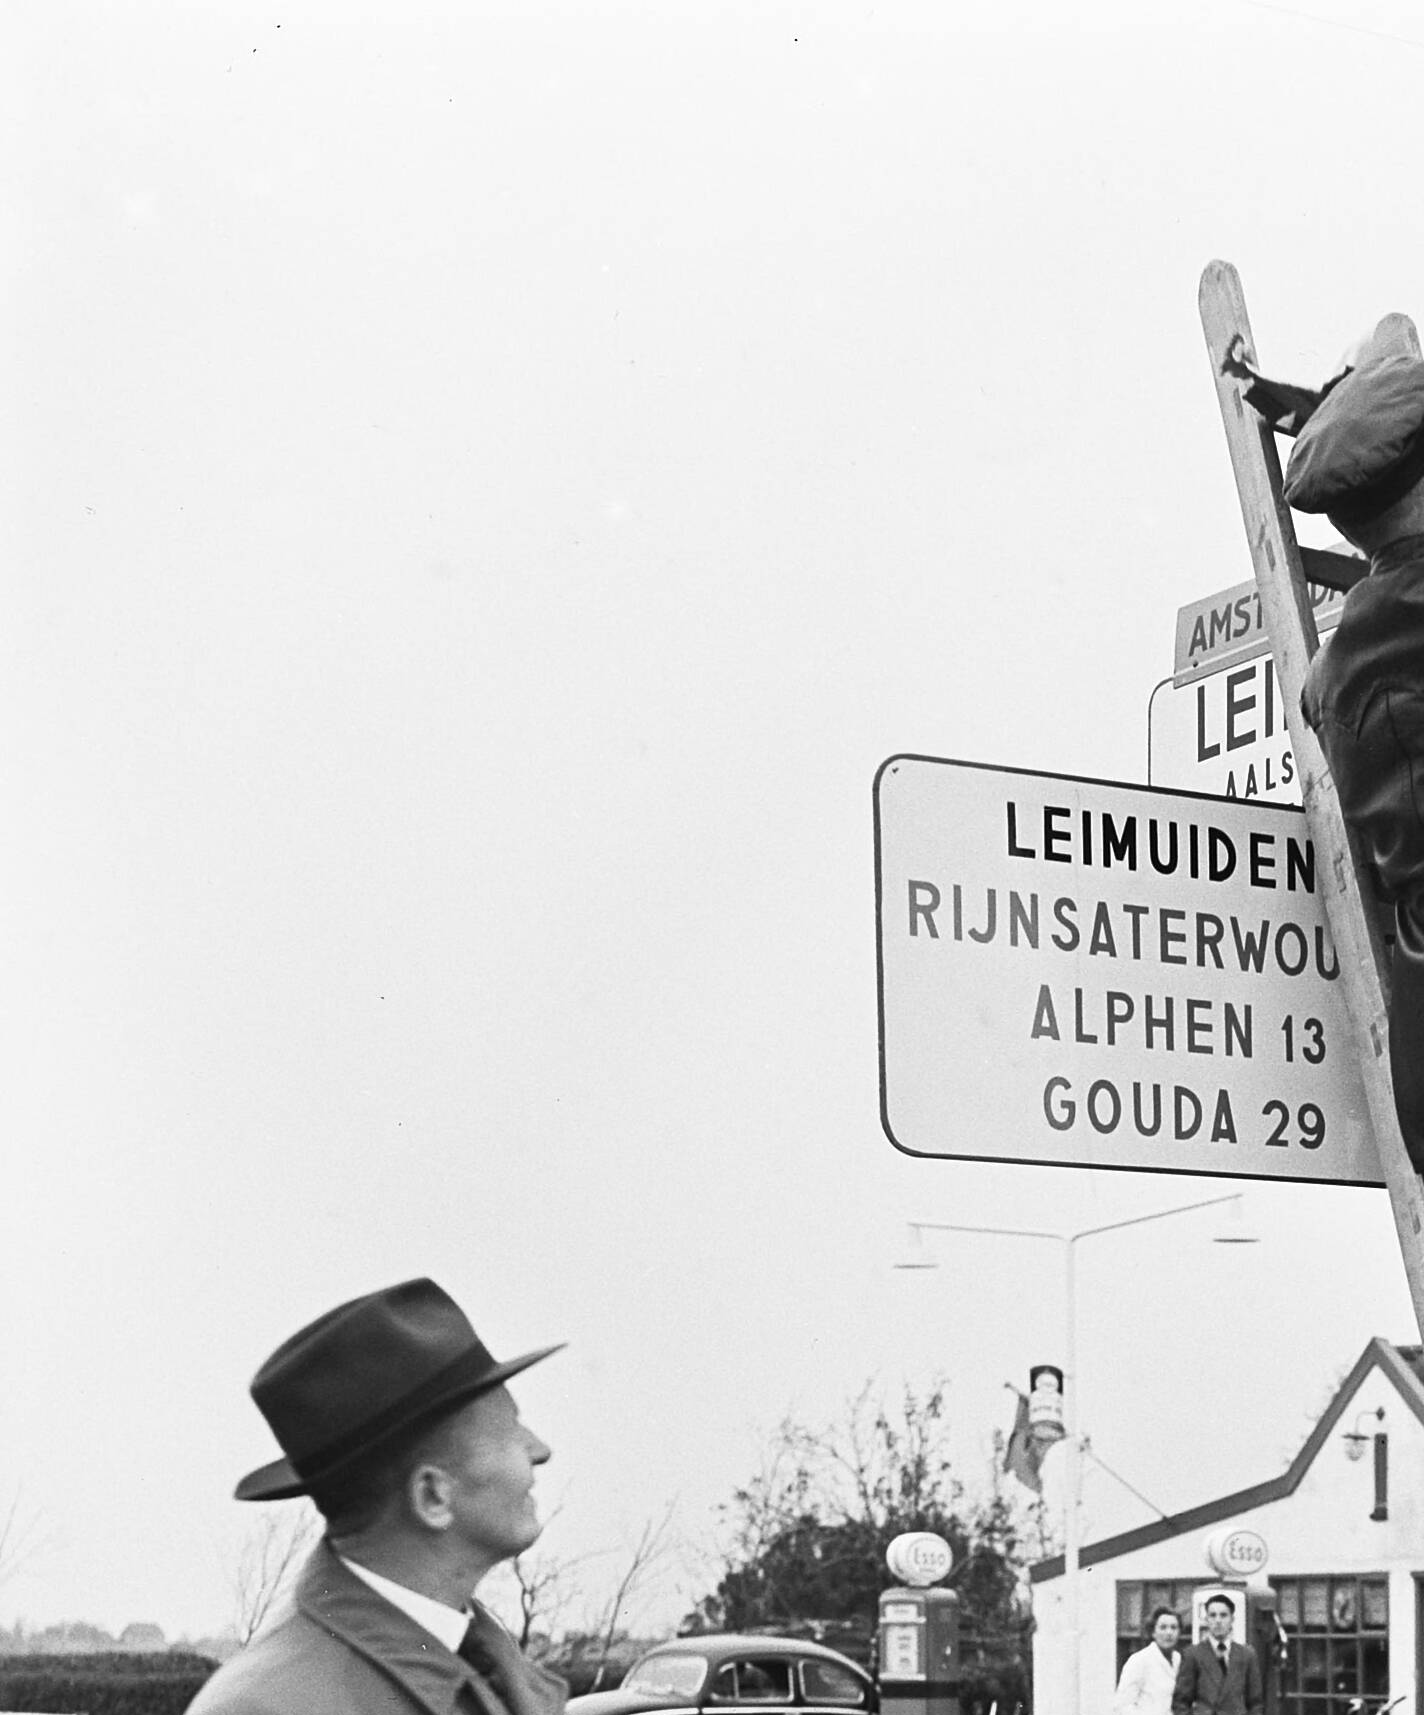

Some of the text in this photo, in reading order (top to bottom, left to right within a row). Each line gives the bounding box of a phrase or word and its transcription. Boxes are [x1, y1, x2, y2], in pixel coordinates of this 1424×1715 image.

[1197, 658, 1289, 763] LEI
[1006, 801, 1316, 895] LEIMUIDEN
[1030, 983, 1327, 1065] ALPHEN 13
[1042, 1075, 1327, 1150] GOUDA 29
